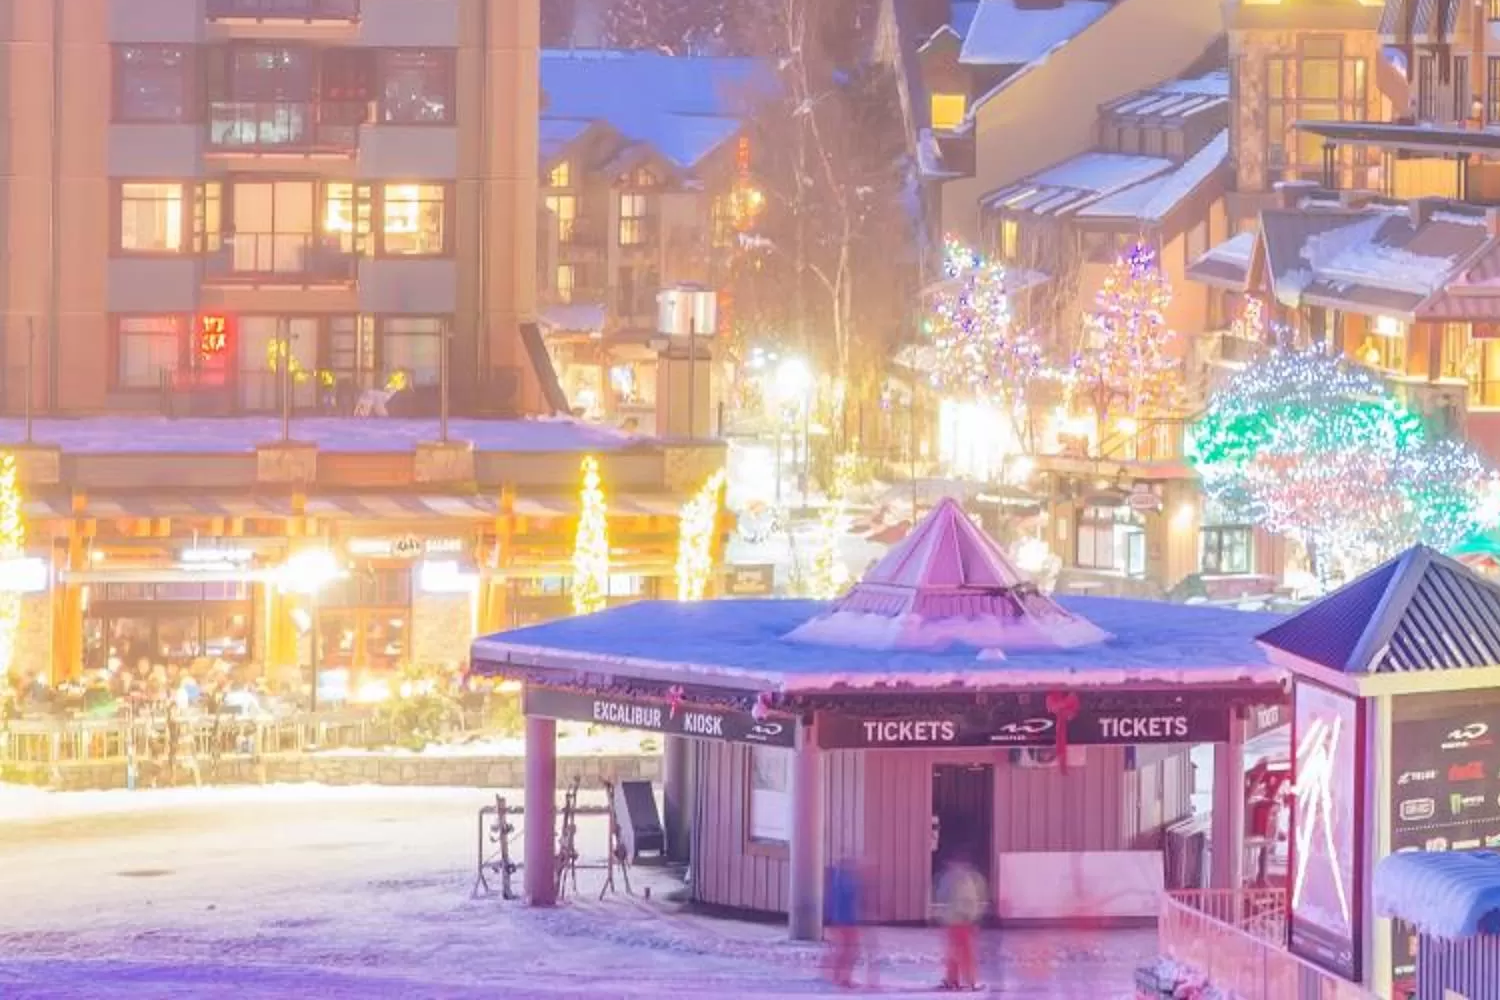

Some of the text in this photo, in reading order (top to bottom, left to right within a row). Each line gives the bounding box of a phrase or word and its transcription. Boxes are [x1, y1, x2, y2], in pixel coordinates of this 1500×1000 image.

[593, 701, 723, 736] EXCALIBUR KIOSK
[1098, 716, 1188, 738] TICKETS
[863, 720, 955, 741] TICKETS
